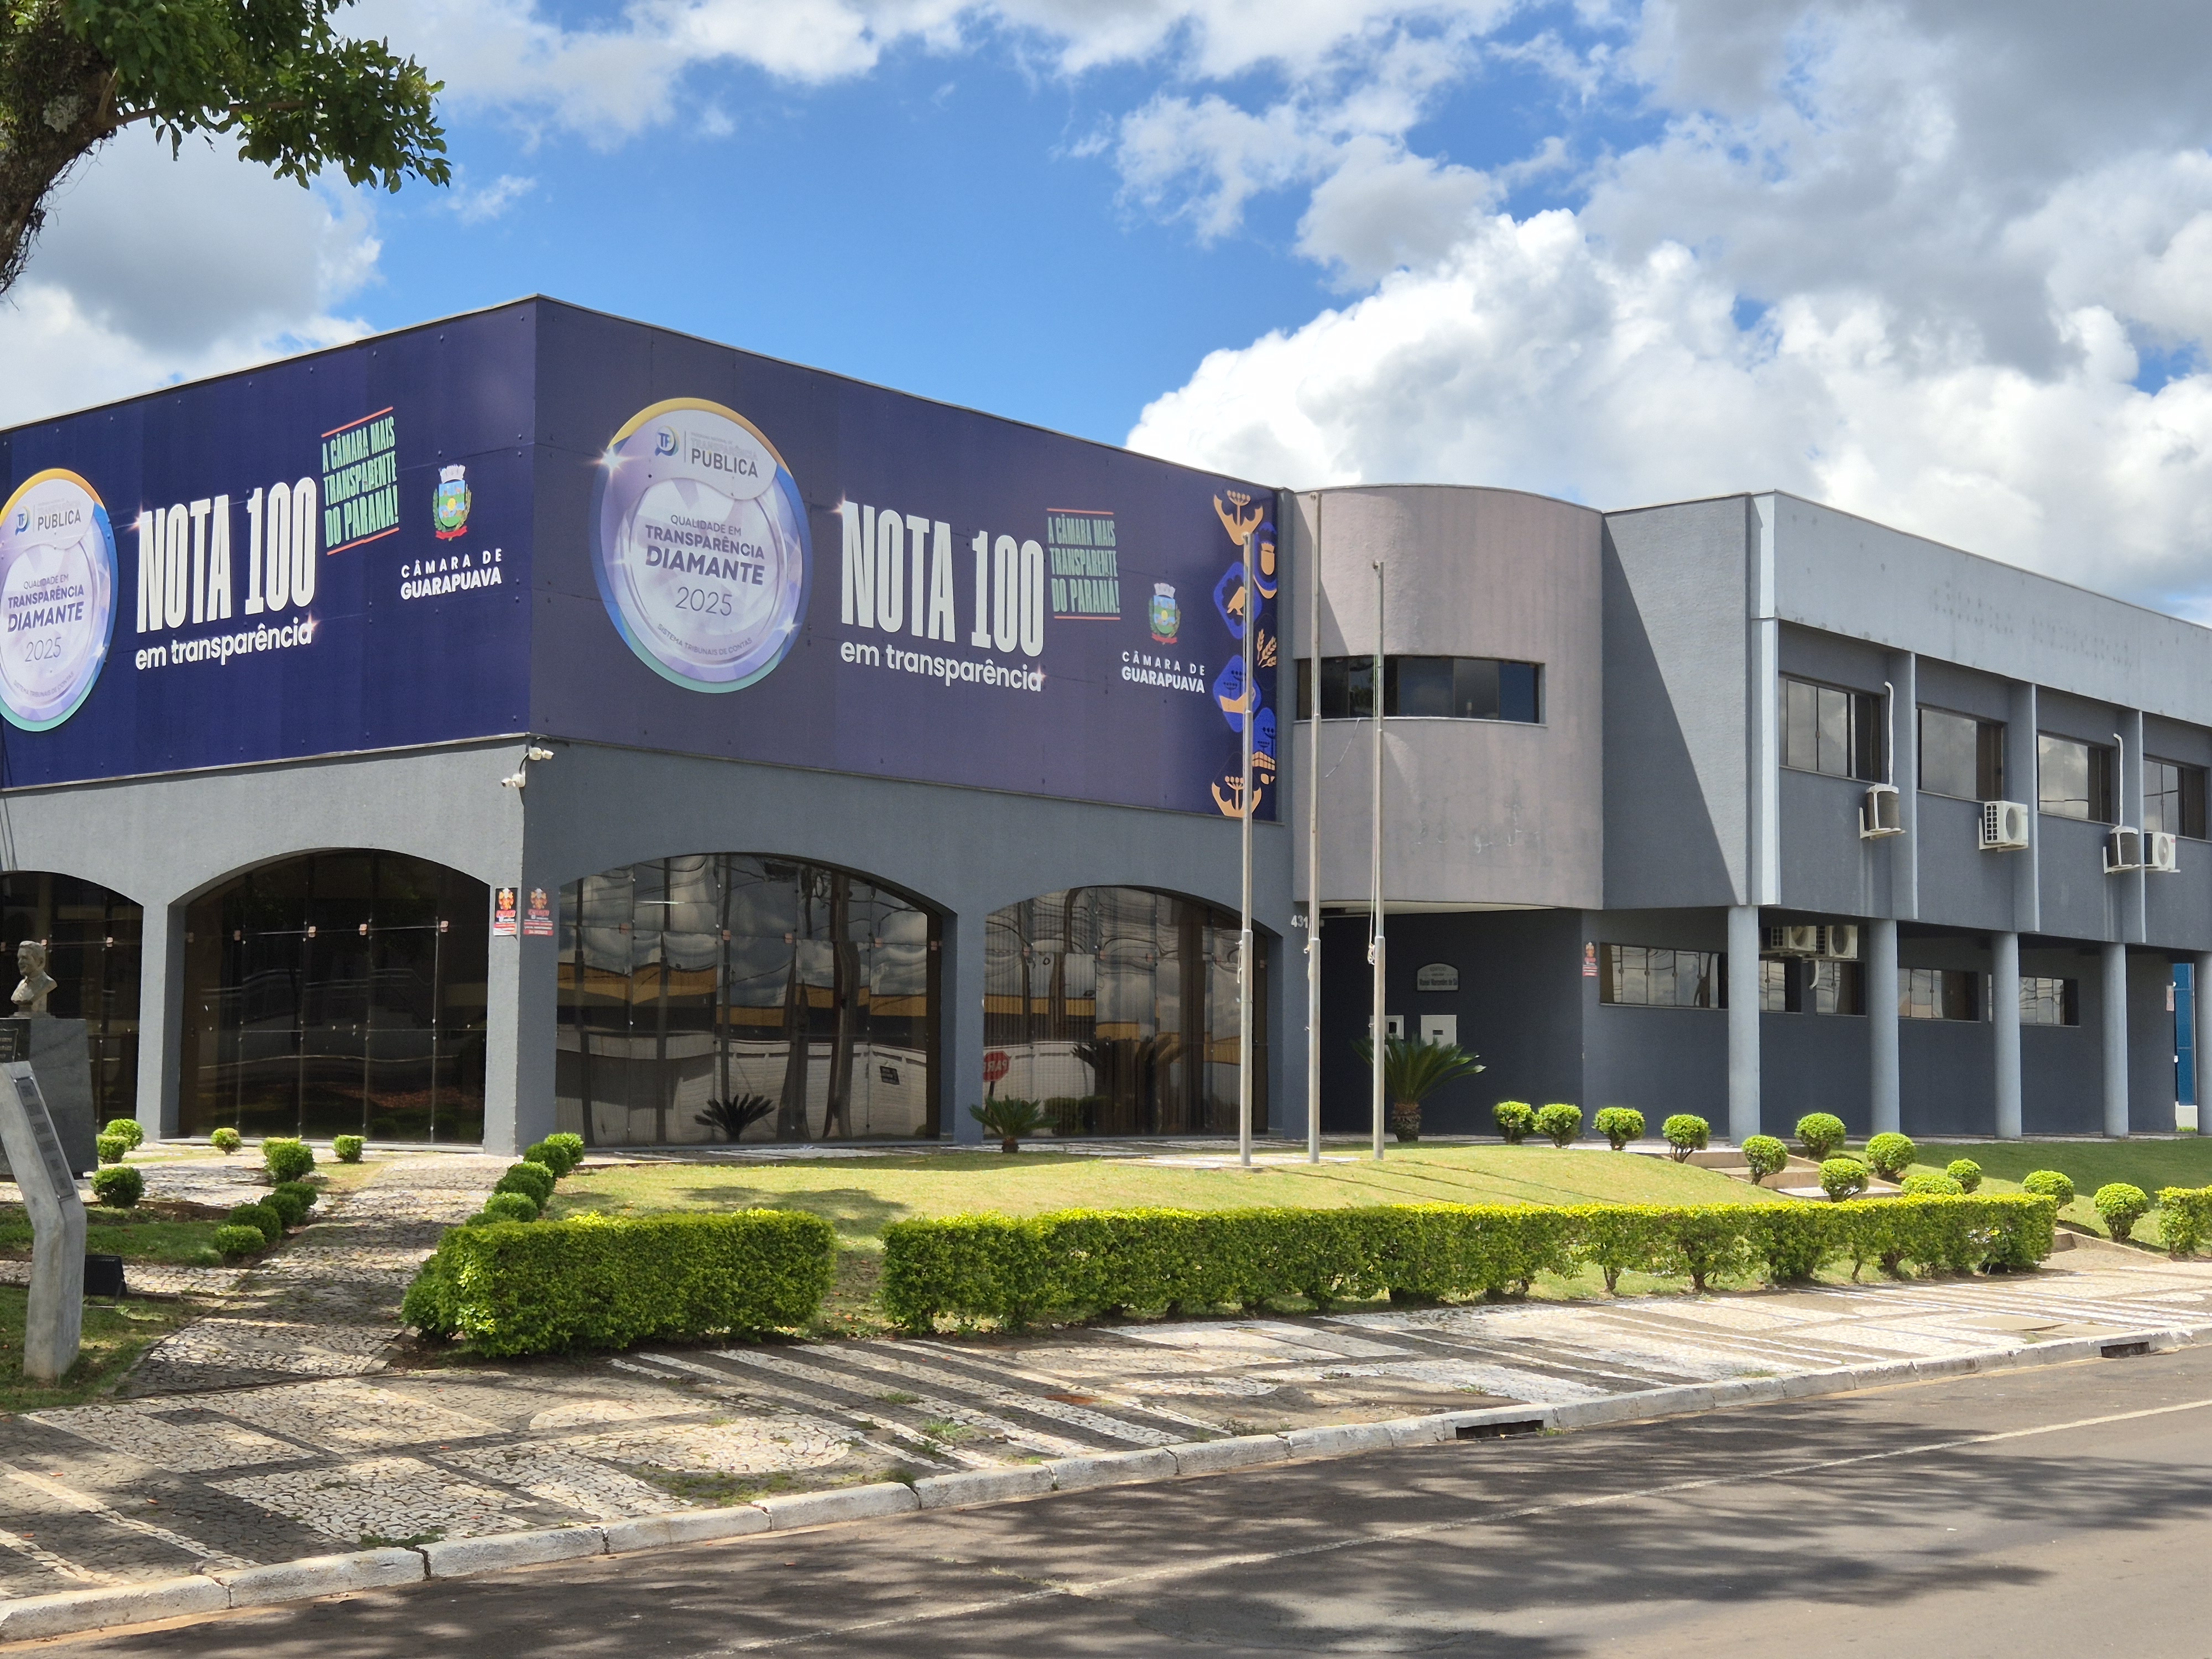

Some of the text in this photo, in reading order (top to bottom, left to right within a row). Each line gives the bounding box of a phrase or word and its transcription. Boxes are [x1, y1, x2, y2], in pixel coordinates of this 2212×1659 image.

[323, 416, 395, 473] A CÂMARA MAIS
[324, 451, 397, 507] TRANSPARENTE
[325, 484, 399, 548] DO PARANÁ!
[671, 514, 742, 536] QUALIDADE EM
[1048, 514, 1116, 547] A CÂMARA MAIS
[137, 477, 316, 633] NOTA 100
[645, 524, 765, 560] TRANSPARÊNCIA
[401, 549, 502, 578] CÂMARA DE
[645, 545, 765, 586] DIAMANTE
[1050, 547, 1118, 577] TRANSPARENTE
[24, 574, 69, 589] QUALIDADE EM
[400, 567, 502, 599] GUARAPUAVA
[841, 500, 1044, 657] NOTA 100
[8, 584, 84, 609] TRANSPARÊNCIA
[675, 587, 733, 616] 2025
[1051, 577, 1120, 613] DO PARANÁ!
[8, 601, 85, 632] DIAMANTE
[25, 637, 61, 662] 2025
[135, 617, 312, 670] em transparência
[658, 623, 683, 646] SISTEMA
[685, 642, 718, 655] TRIBUNAIS
[728, 637, 753, 653] CONTAS
[841, 641, 1042, 692] em transparência
[1122, 650, 1205, 676] CÂMARA DE
[1121, 666, 1205, 693] GUARAPUAVA
[1291, 915, 1308, 928] 431
